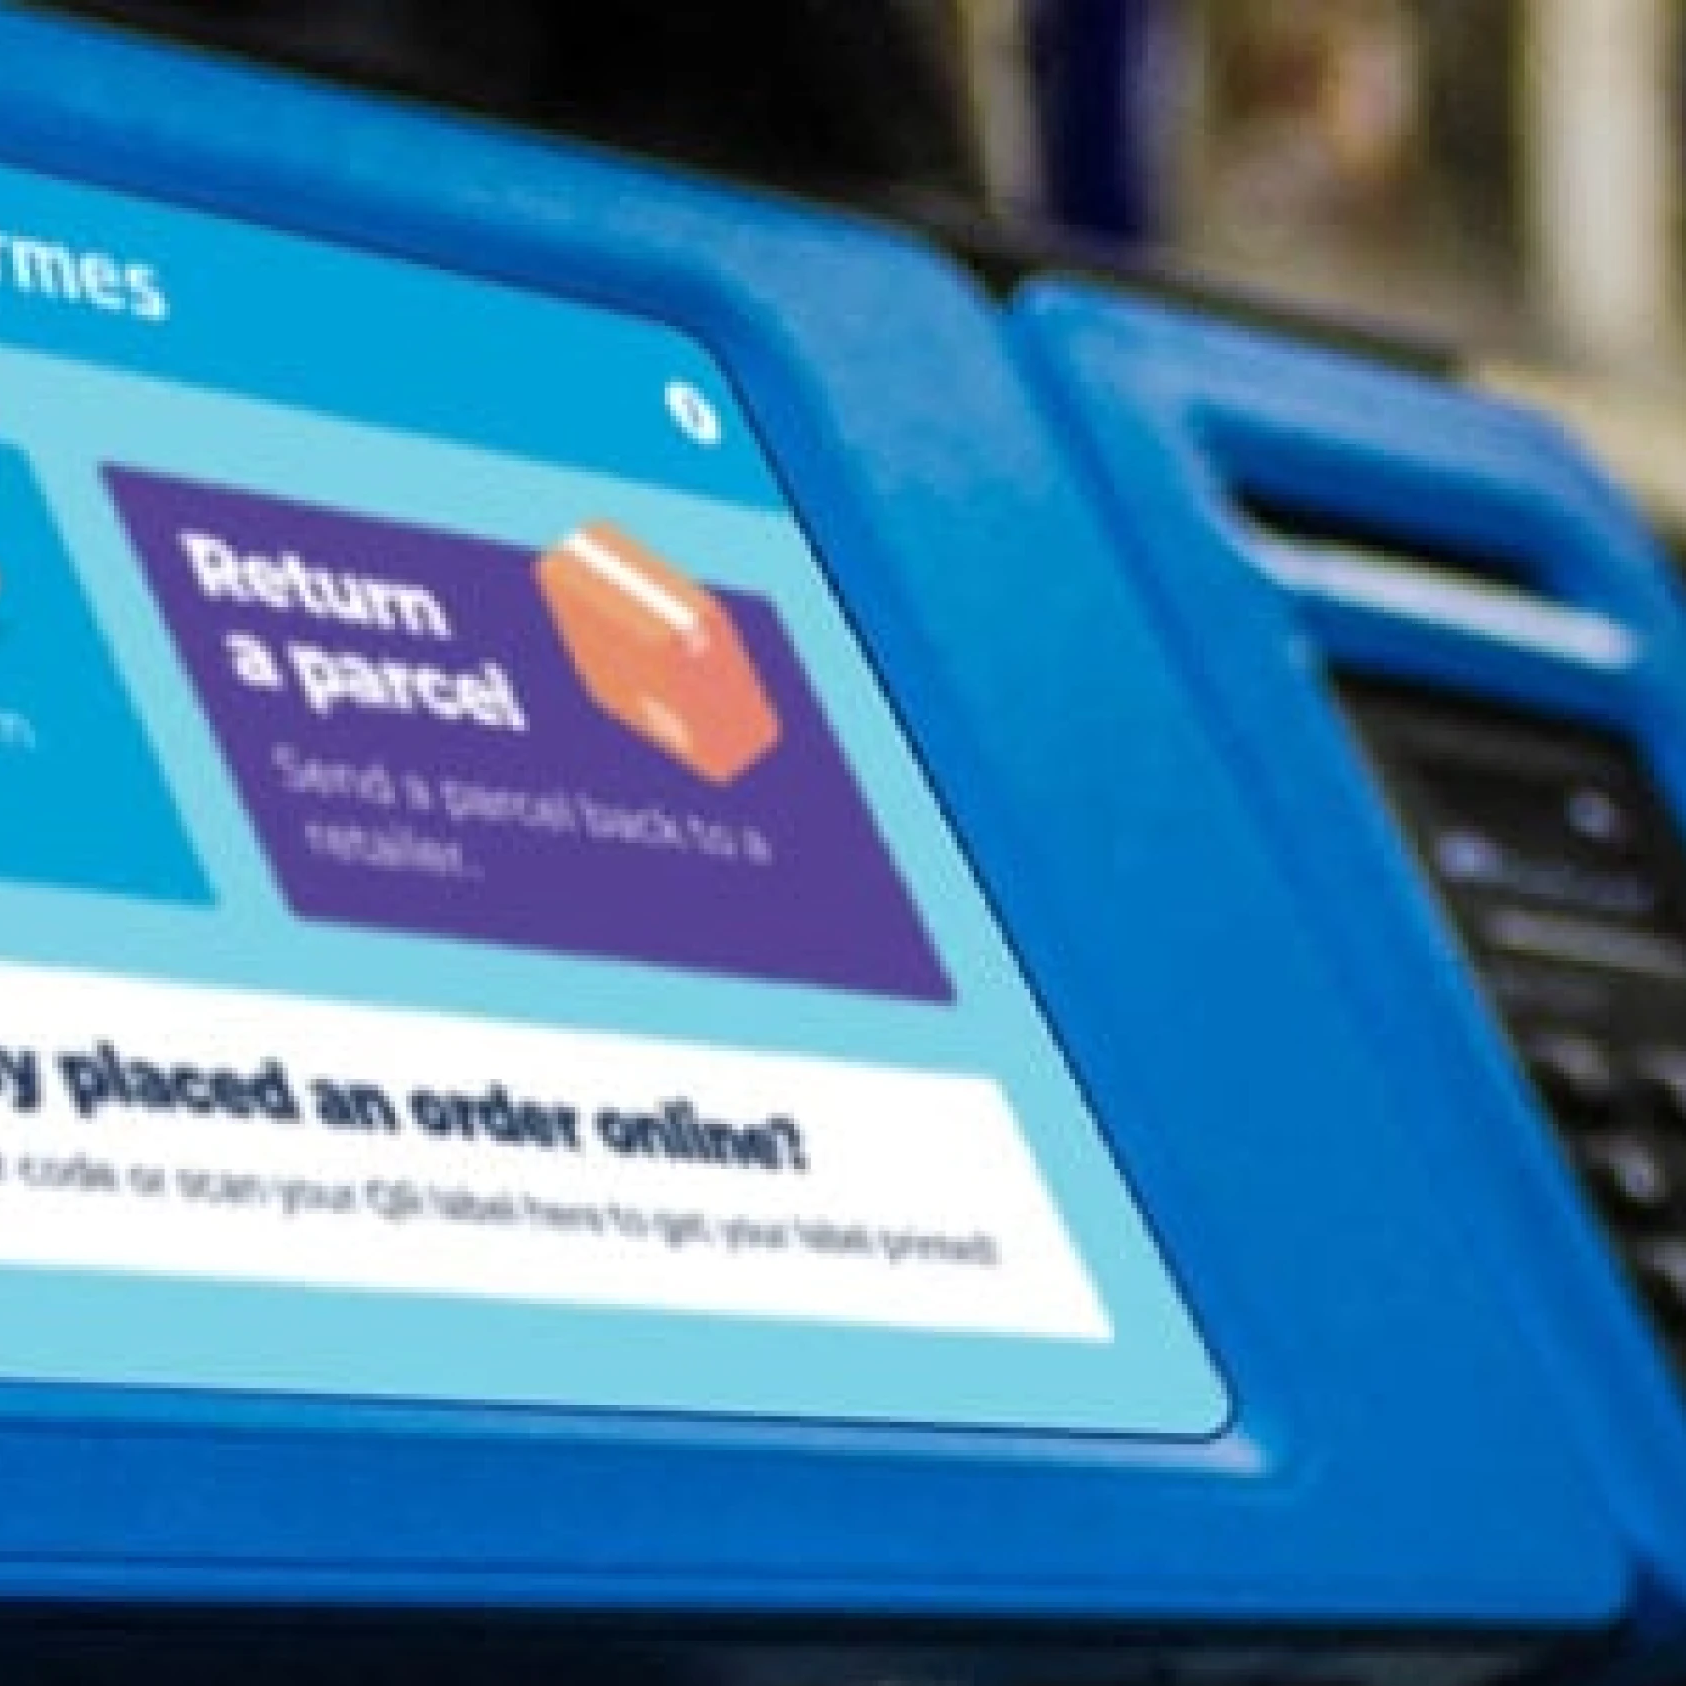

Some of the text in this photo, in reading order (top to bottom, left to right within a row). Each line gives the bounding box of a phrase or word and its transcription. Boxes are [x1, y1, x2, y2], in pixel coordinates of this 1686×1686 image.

[179, 528, 453, 640] Return
[225, 630, 529, 732] a parcel
[270, 740, 397, 805] Send
[403, 770, 433, 810] a
[438, 778, 577, 834] parcel
[578, 793, 685, 850] back
[686, 813, 739, 859] to
[55, 1036, 303, 1122] placed
[307, 1076, 400, 1136] an
[407, 1077, 585, 1152] order
[593, 1094, 813, 1175] online?
[14, 1148, 119, 1196] code
[175, 1163, 265, 1206] scan
